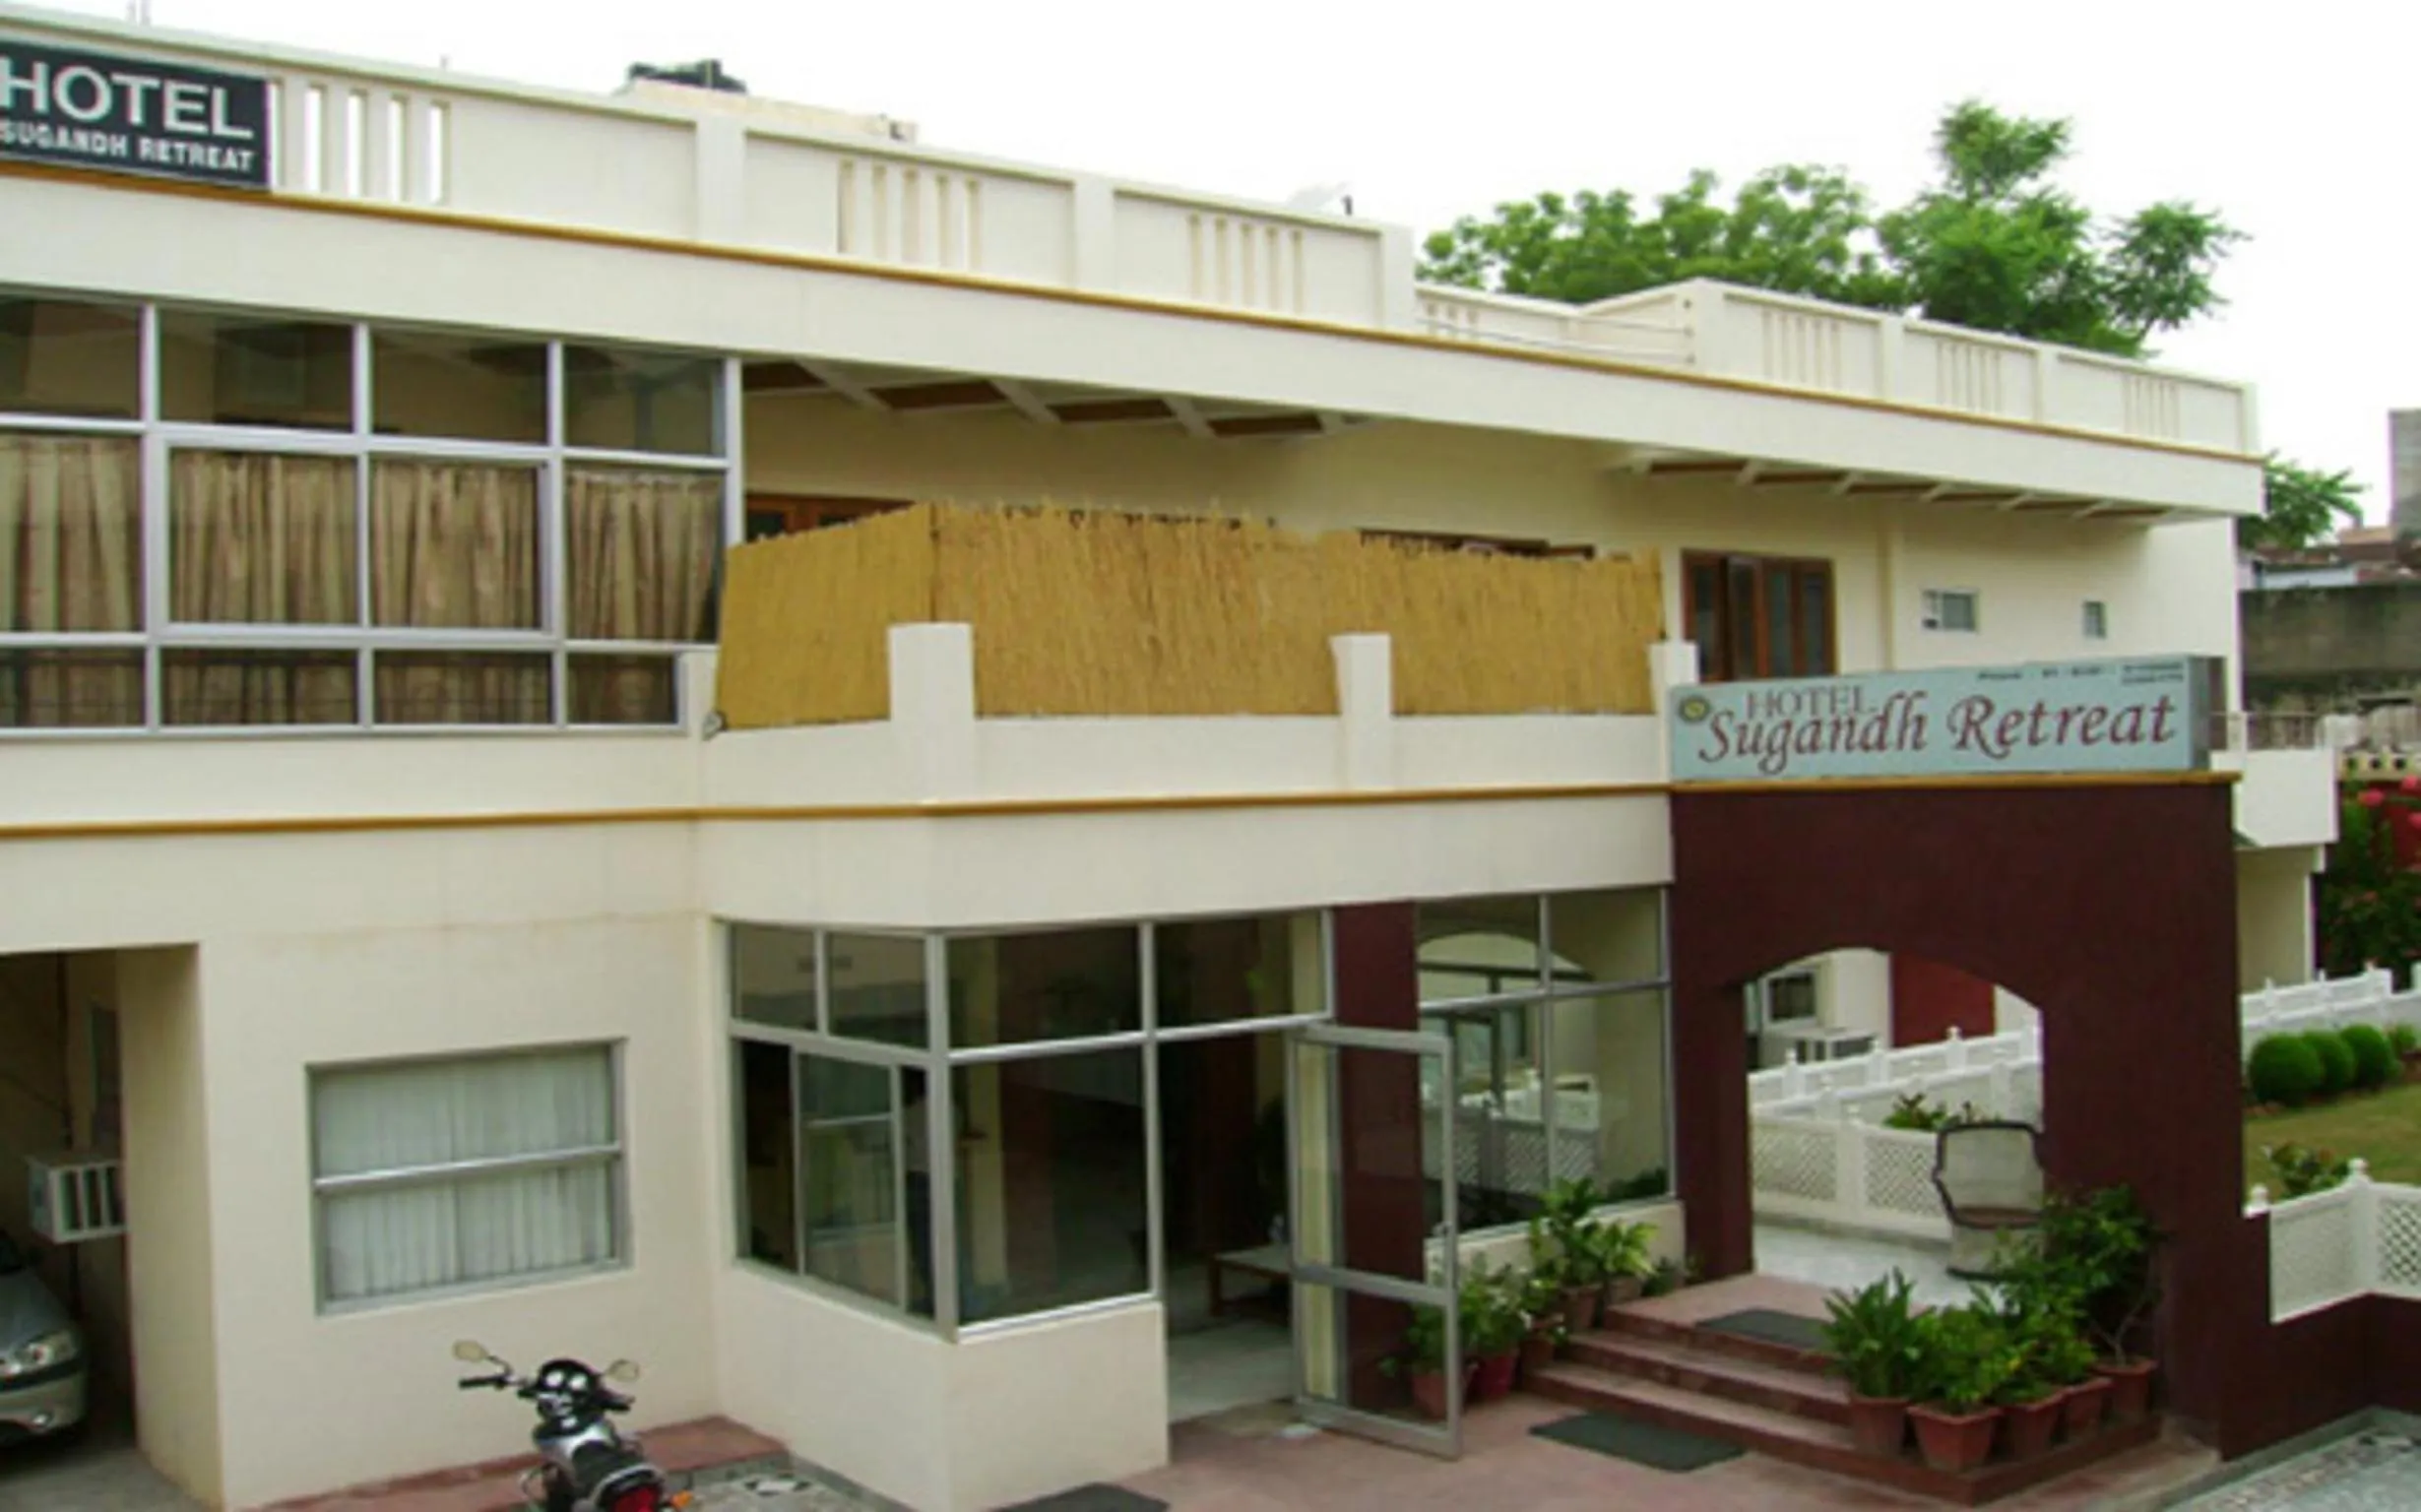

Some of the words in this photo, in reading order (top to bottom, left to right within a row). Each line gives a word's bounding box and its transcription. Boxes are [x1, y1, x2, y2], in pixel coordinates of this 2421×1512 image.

[0, 55, 254, 139] HOTEL
[0, 118, 129, 158] SUGANDH
[138, 137, 255, 172] RETREAT
[1698, 689, 1928, 776] Sugandh
[1946, 694, 2177, 760] Retreat
[1746, 685, 1877, 720] HOTEL
